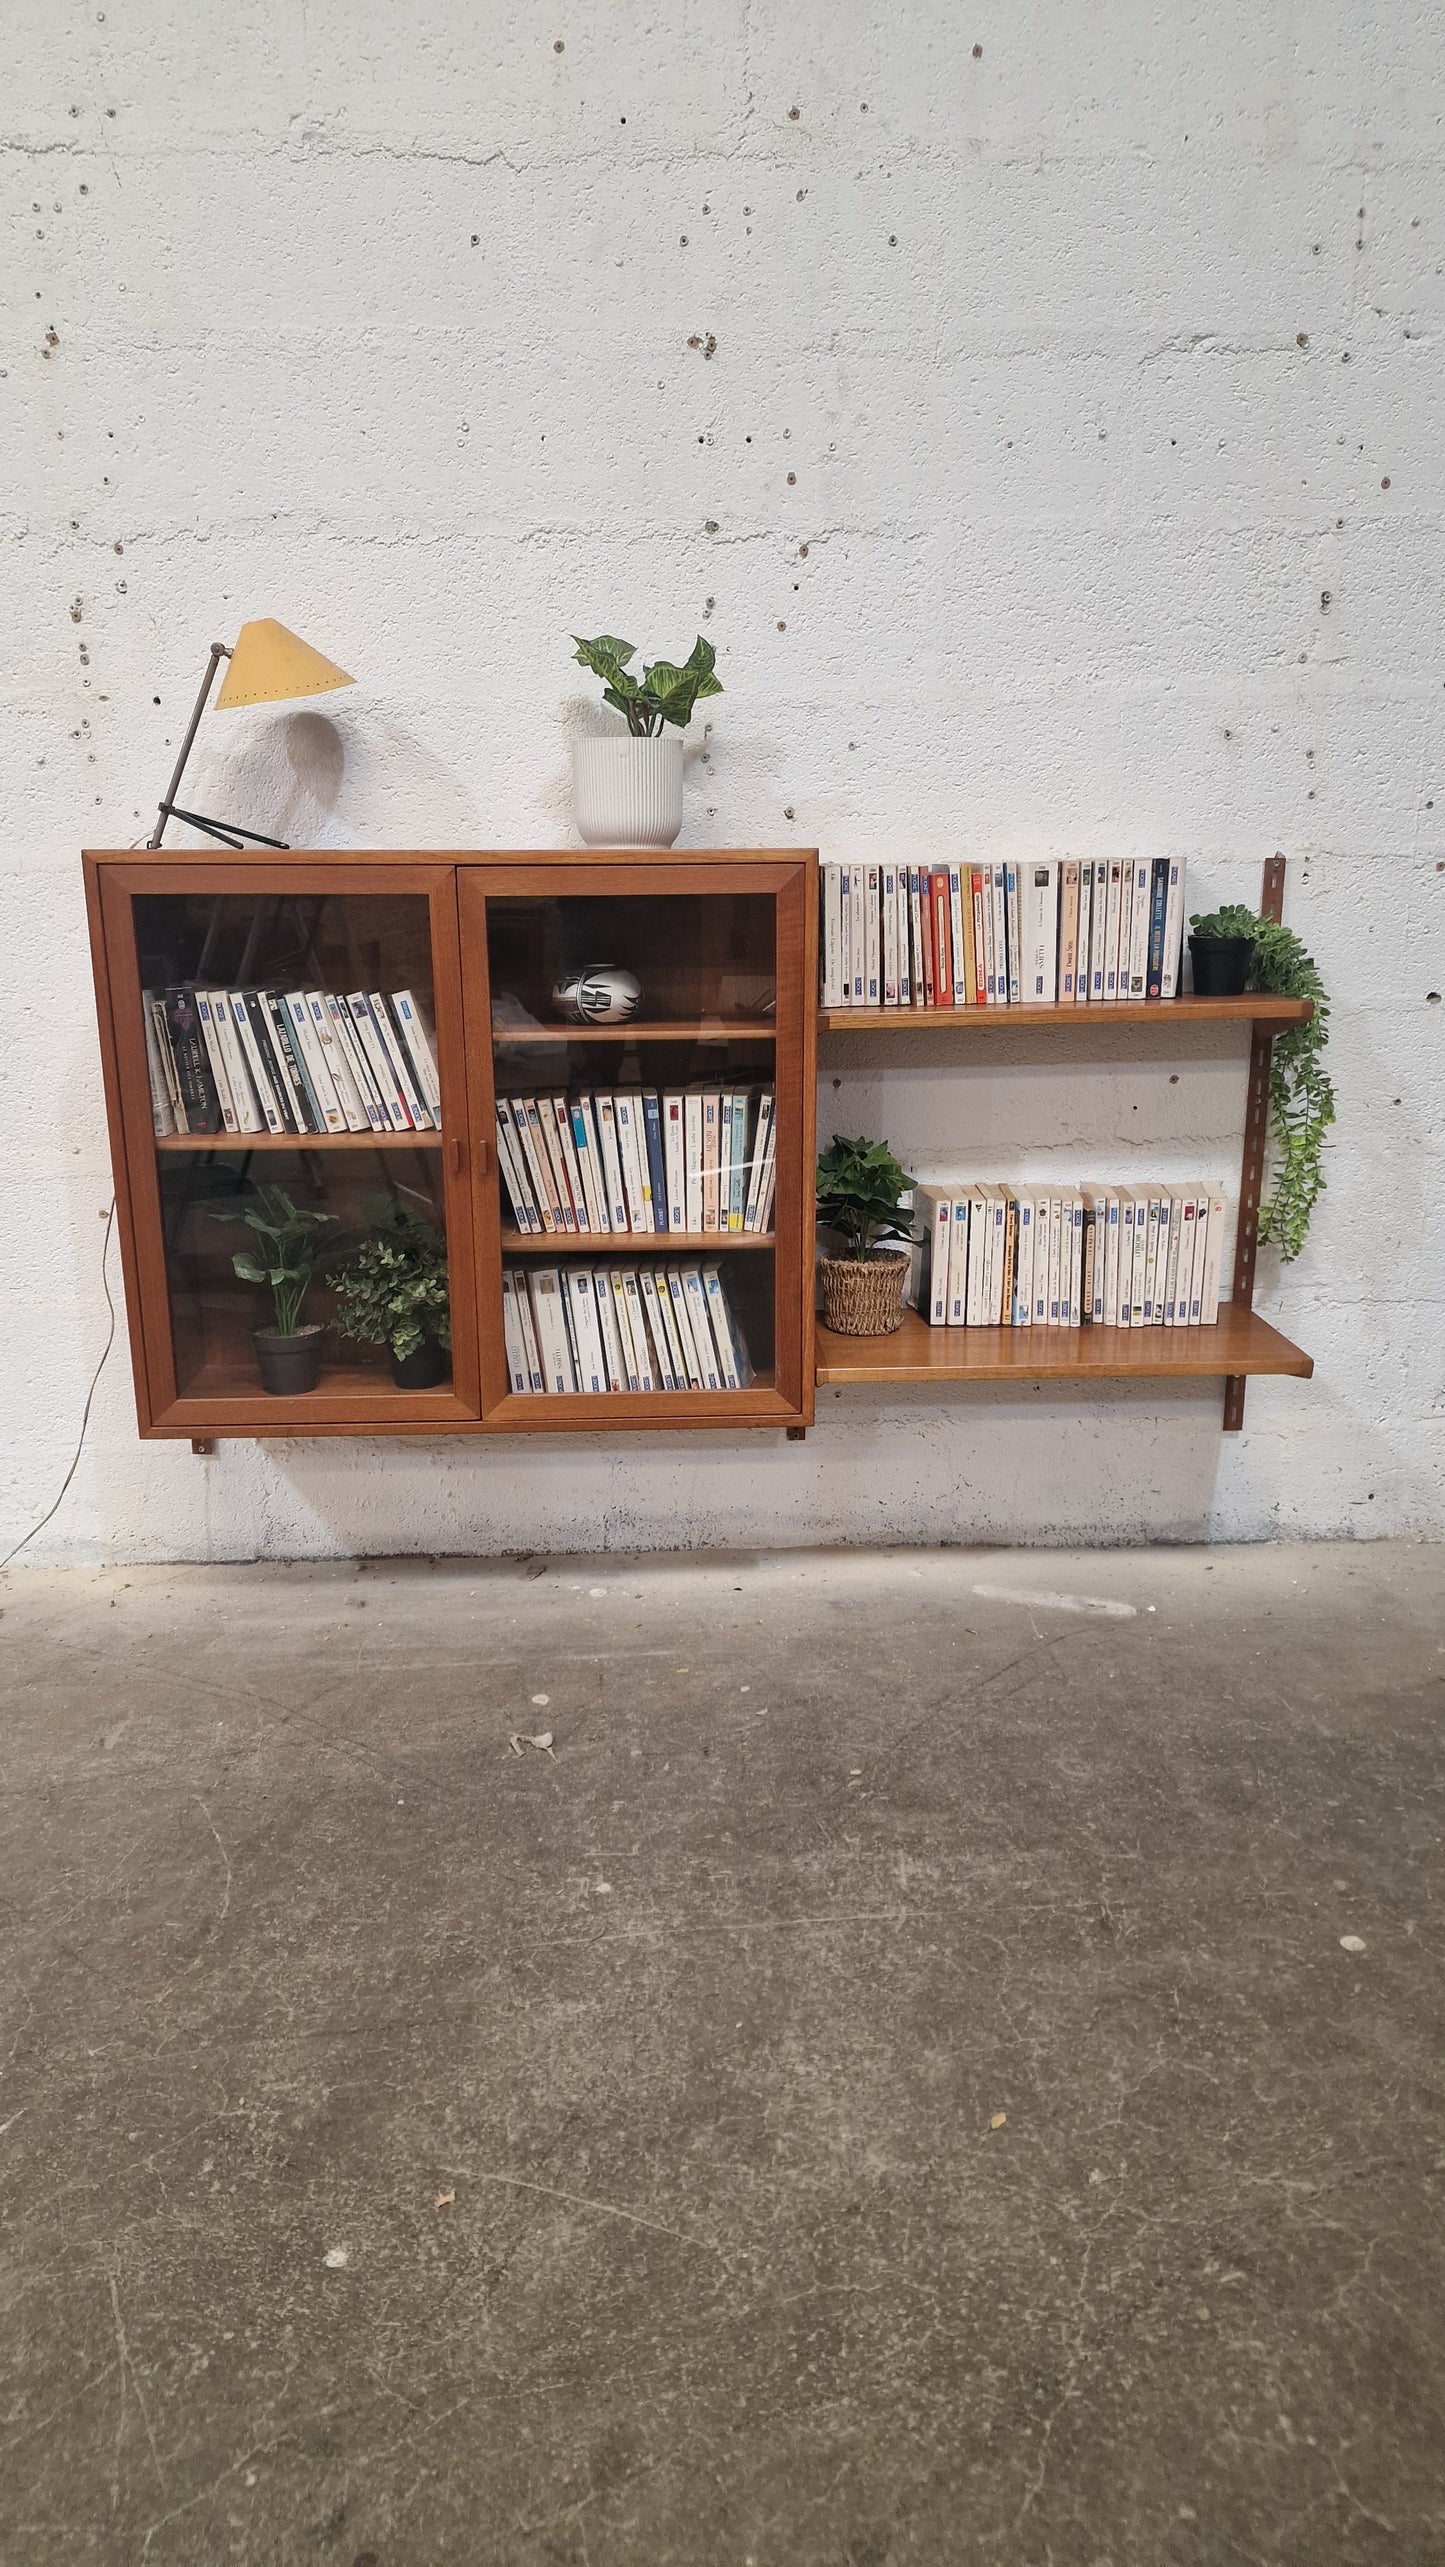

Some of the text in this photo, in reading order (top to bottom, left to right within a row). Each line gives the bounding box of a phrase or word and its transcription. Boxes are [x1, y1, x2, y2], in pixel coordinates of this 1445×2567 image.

[235, 1003, 245, 1022] POCKET
[400, 1000, 411, 1020] POCKET
[276, 1024, 292, 1052] LAZARILLO
[288, 1065, 302, 1085] TORMES
[274, 1084, 284, 1102] SOURCES
